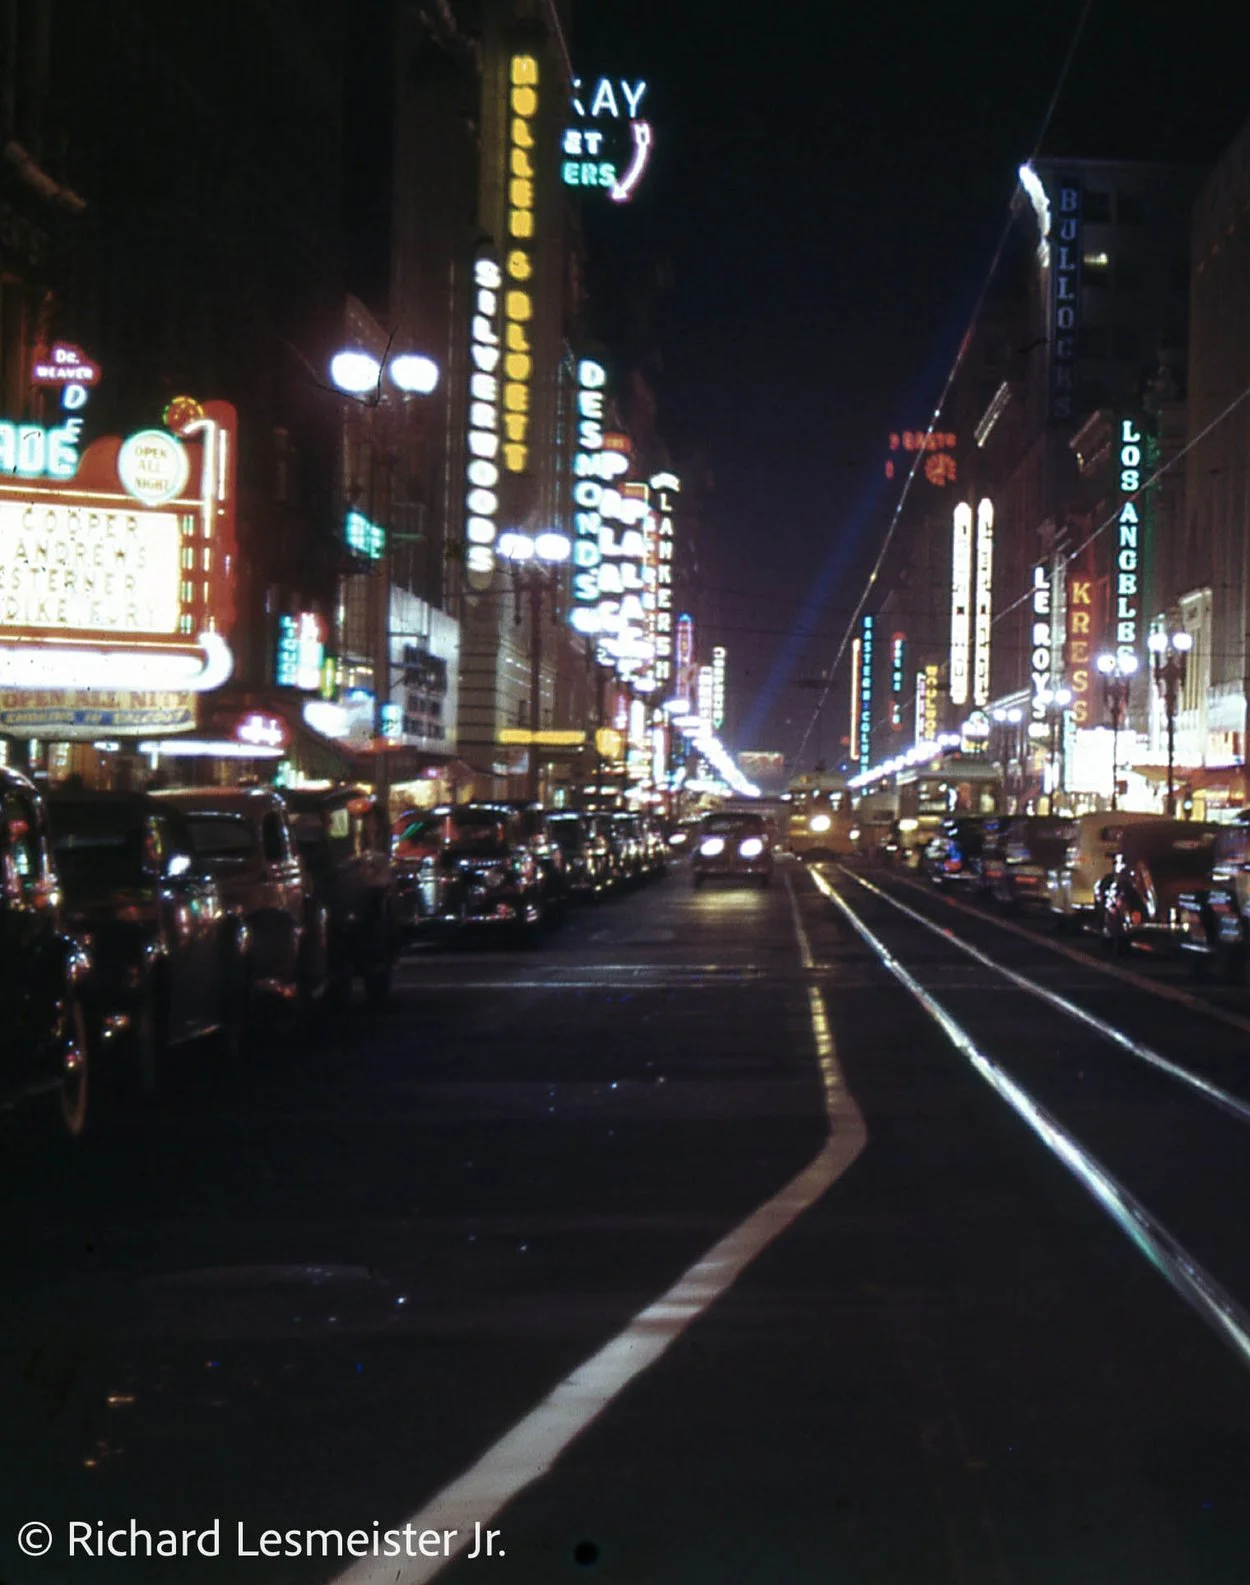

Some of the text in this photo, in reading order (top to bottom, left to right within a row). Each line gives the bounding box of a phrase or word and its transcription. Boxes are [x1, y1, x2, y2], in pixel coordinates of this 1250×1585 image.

[510, 55, 538, 237] MULLEN
[466, 259, 501, 572] SILVERWOODS
[505, 291, 531, 471] BLUETT
[134, 446, 168, 458] OPEN
[137, 459, 162, 473] ALL
[1120, 420, 1140, 492] LOS
[14, 538, 147, 568] ANDREWS
[22, 507, 139, 537] COOPER
[1069, 581, 1092, 723] KRESS
